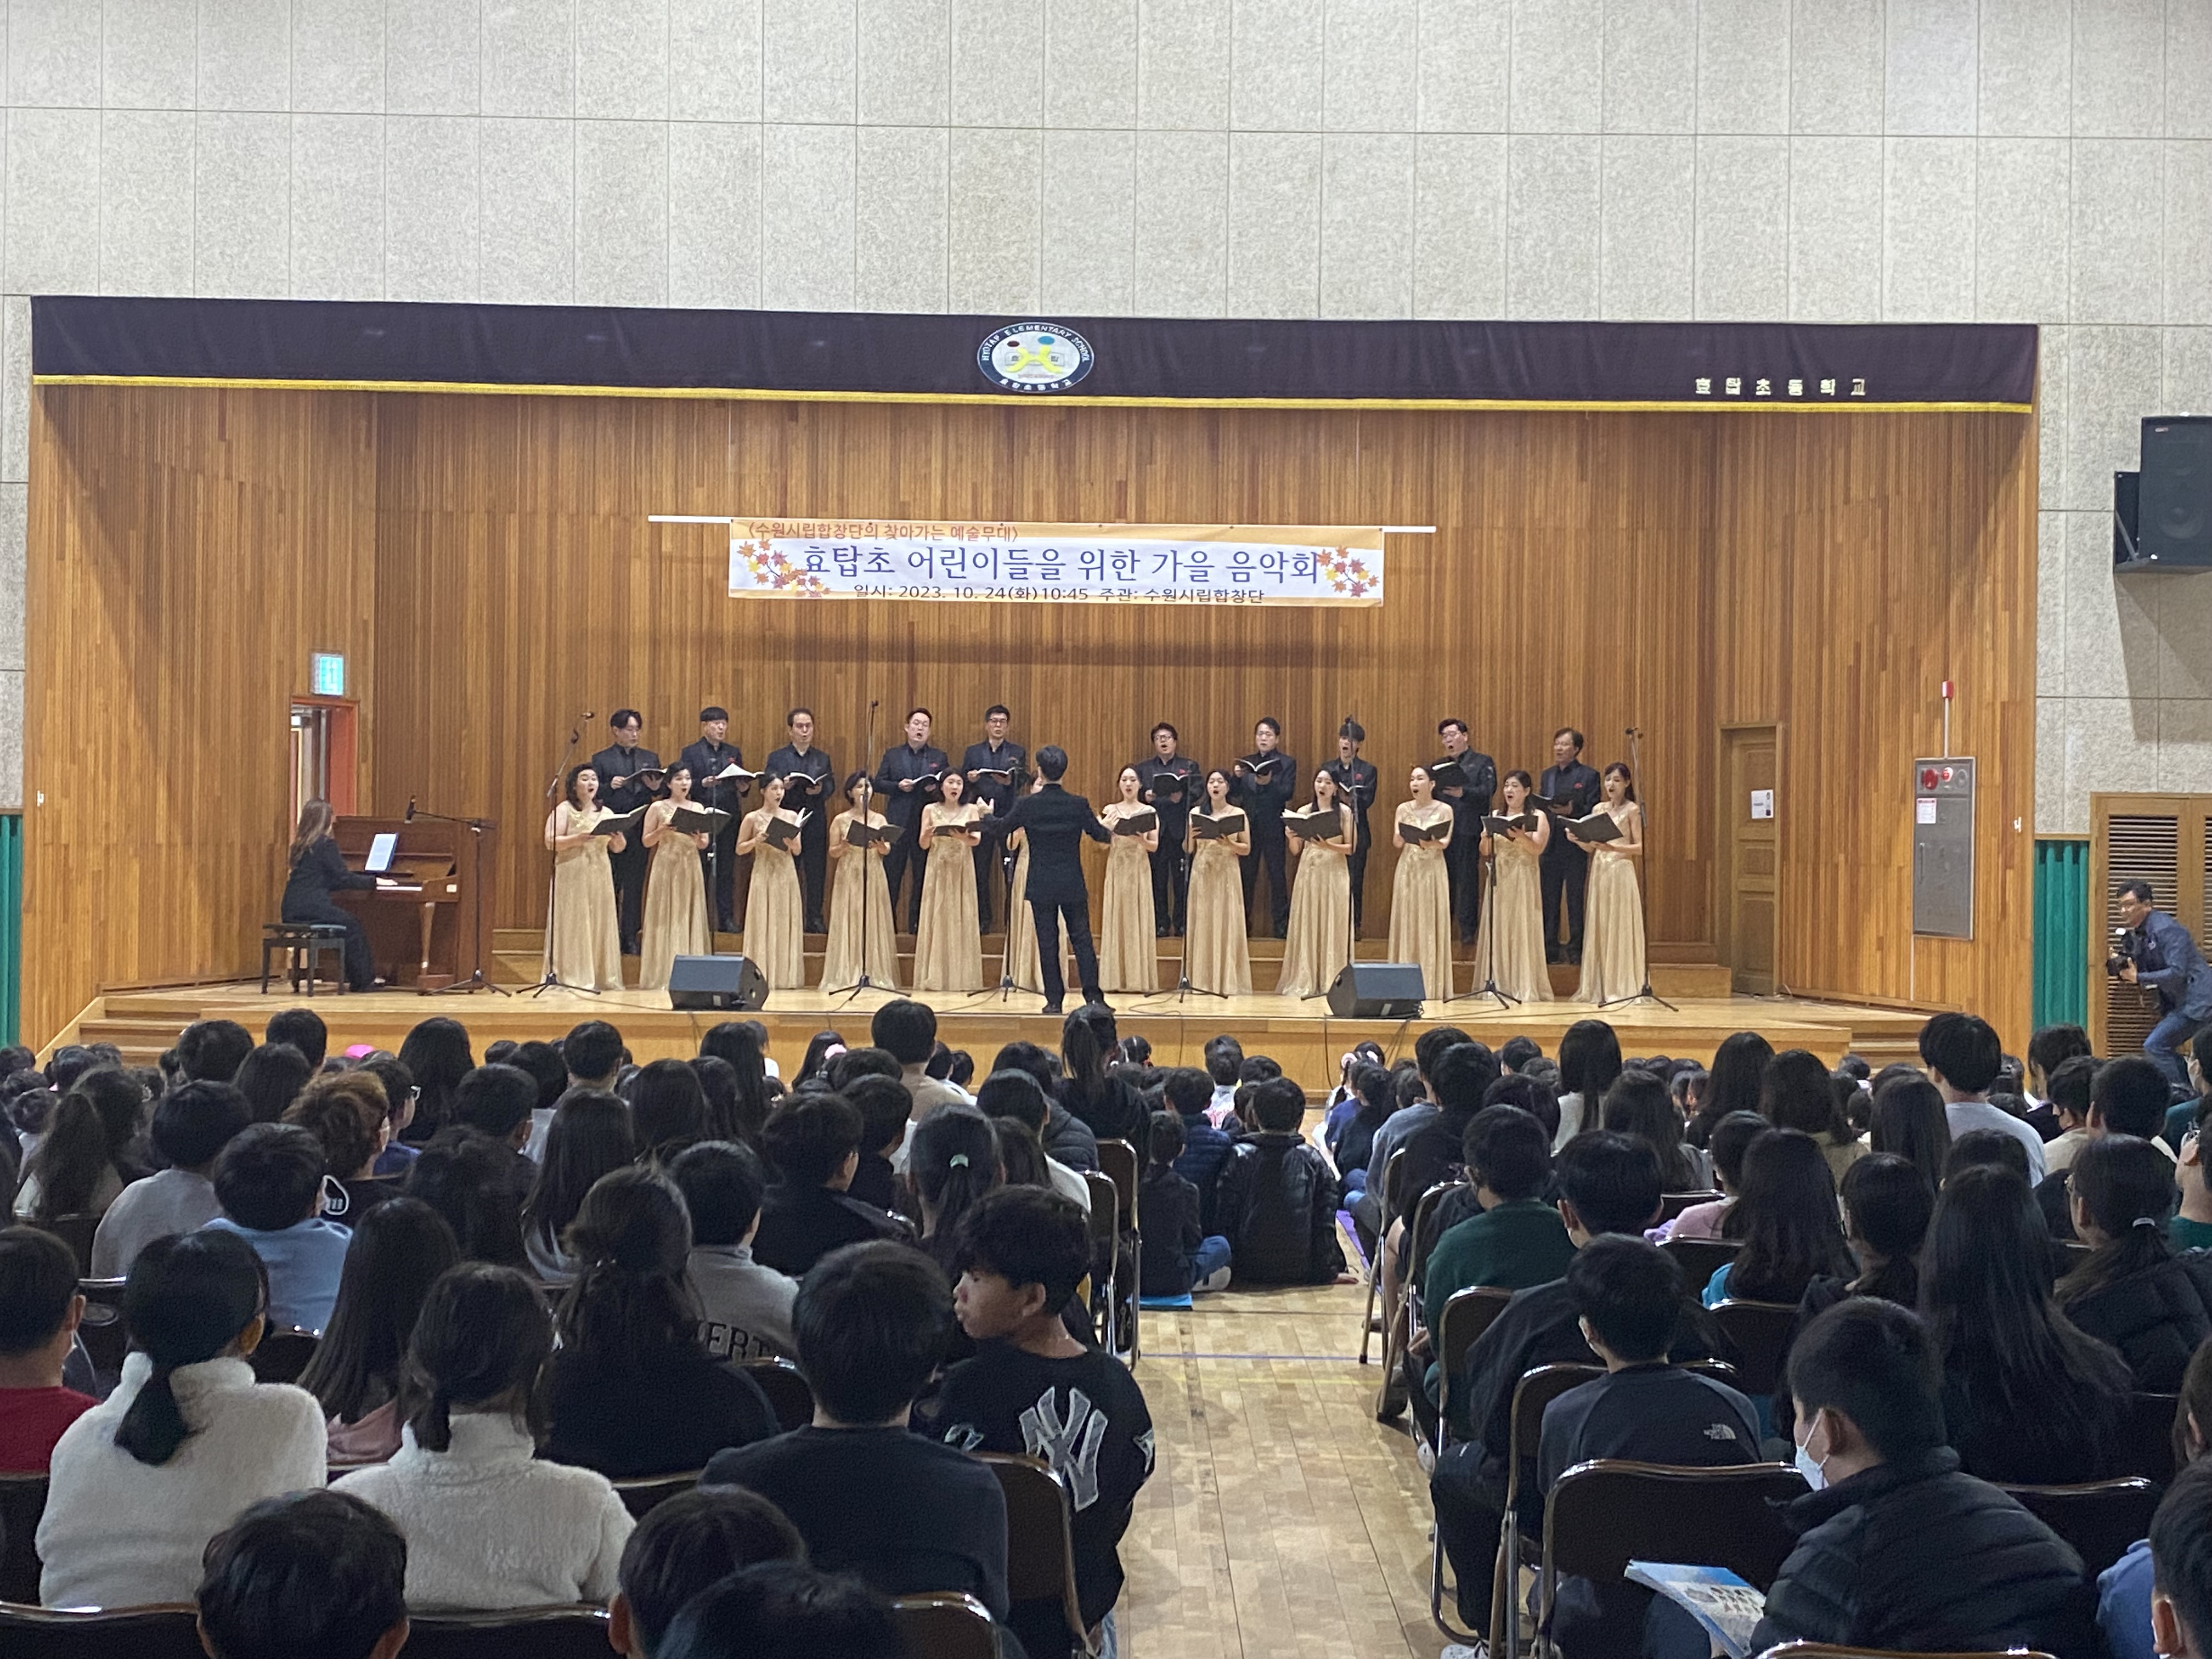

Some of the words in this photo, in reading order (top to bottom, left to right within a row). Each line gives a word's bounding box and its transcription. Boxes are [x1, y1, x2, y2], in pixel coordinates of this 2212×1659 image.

[884, 523, 945, 541] 찾아가는
[804, 545, 895, 577] 효탑초
[907, 546, 1066, 582] 어린이들을
[1077, 548, 1141, 582] 위한
[1152, 550, 1215, 583] 가을
[1225, 550, 1319, 585] 음악회
[854, 584, 893, 598] 일시:
[899, 585, 946, 599] 2023.
[953, 586, 978, 599] 10.
[1098, 588, 1138, 602] 주관:
[1143, 588, 1265, 603] 수원시립합창단
[1019, 1386, 1109, 1513] NY
